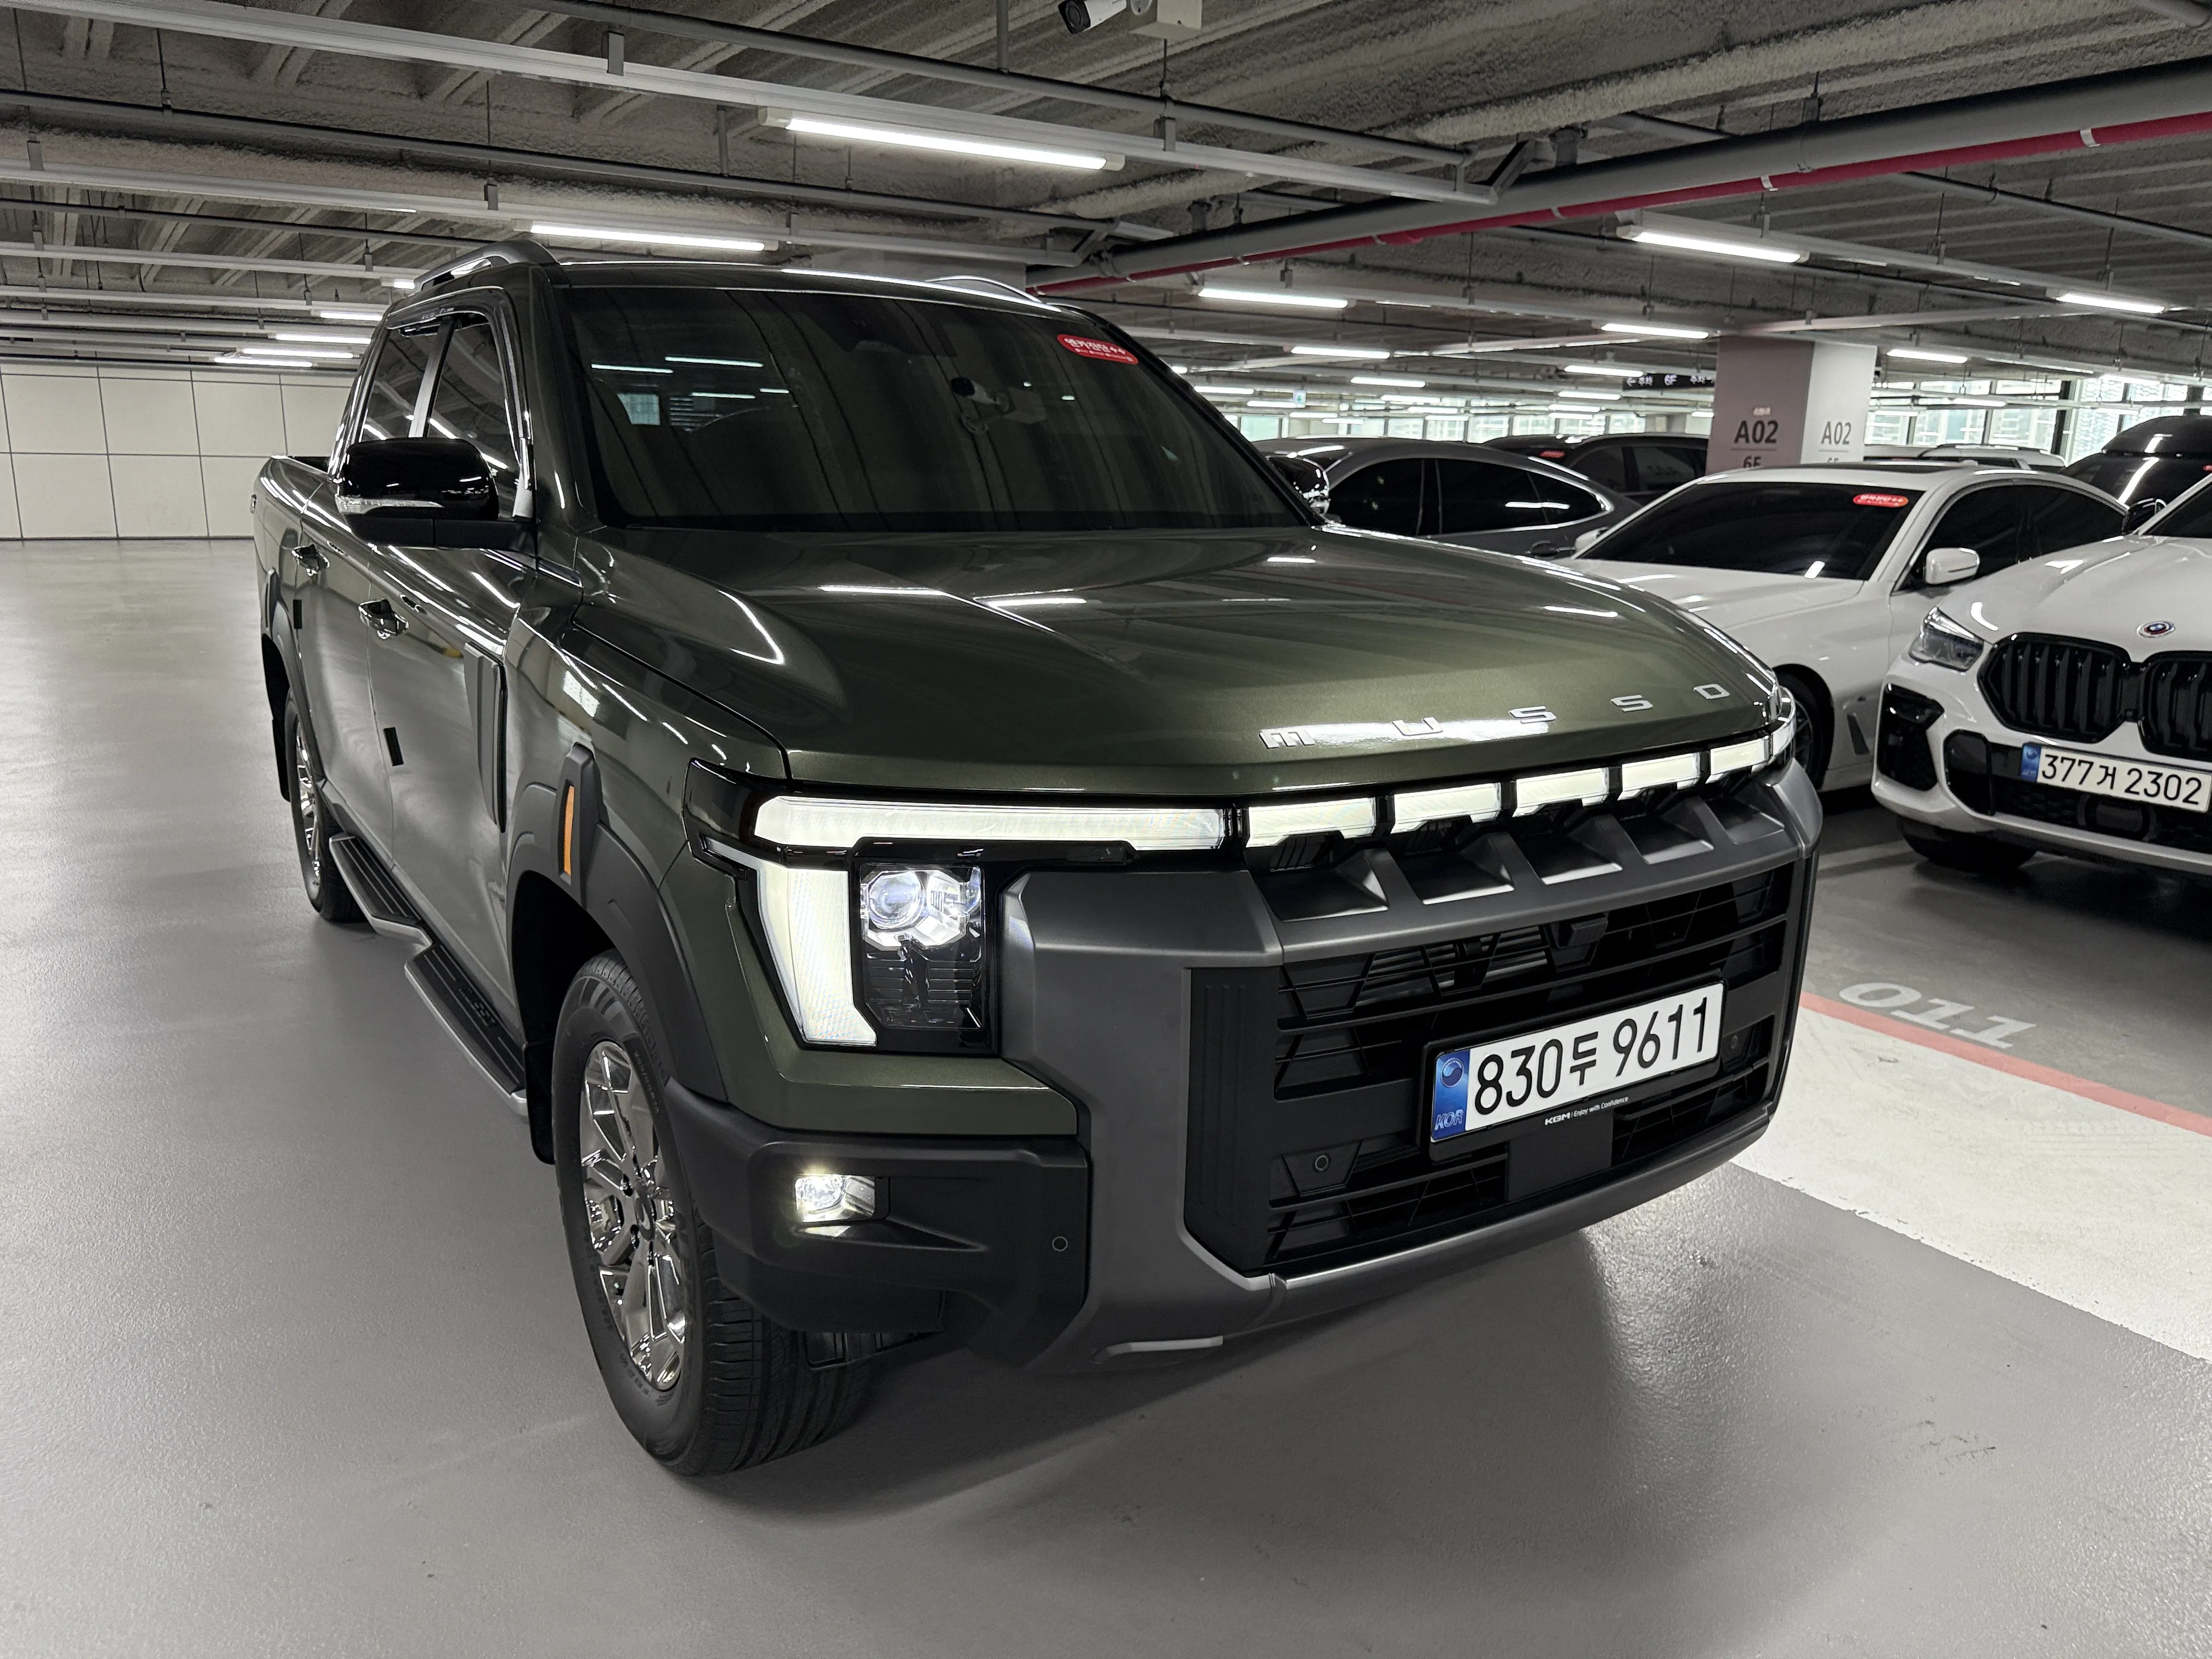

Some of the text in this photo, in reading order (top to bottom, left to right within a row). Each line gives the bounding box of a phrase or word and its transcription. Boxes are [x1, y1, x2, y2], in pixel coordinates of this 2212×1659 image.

[1734, 420, 1779, 444] A02
[1821, 421, 1851, 445] A02
[1259, 683, 1730, 749] MUSSO
[2041, 754, 2202, 805] 377거 2302
[1839, 983, 2036, 1049] 011
[1475, 996, 1707, 1115] 830두 9611
[1434, 1109, 1464, 1131] KOR
[1544, 1096, 1629, 1126] KGM Enjoy with Confidence
